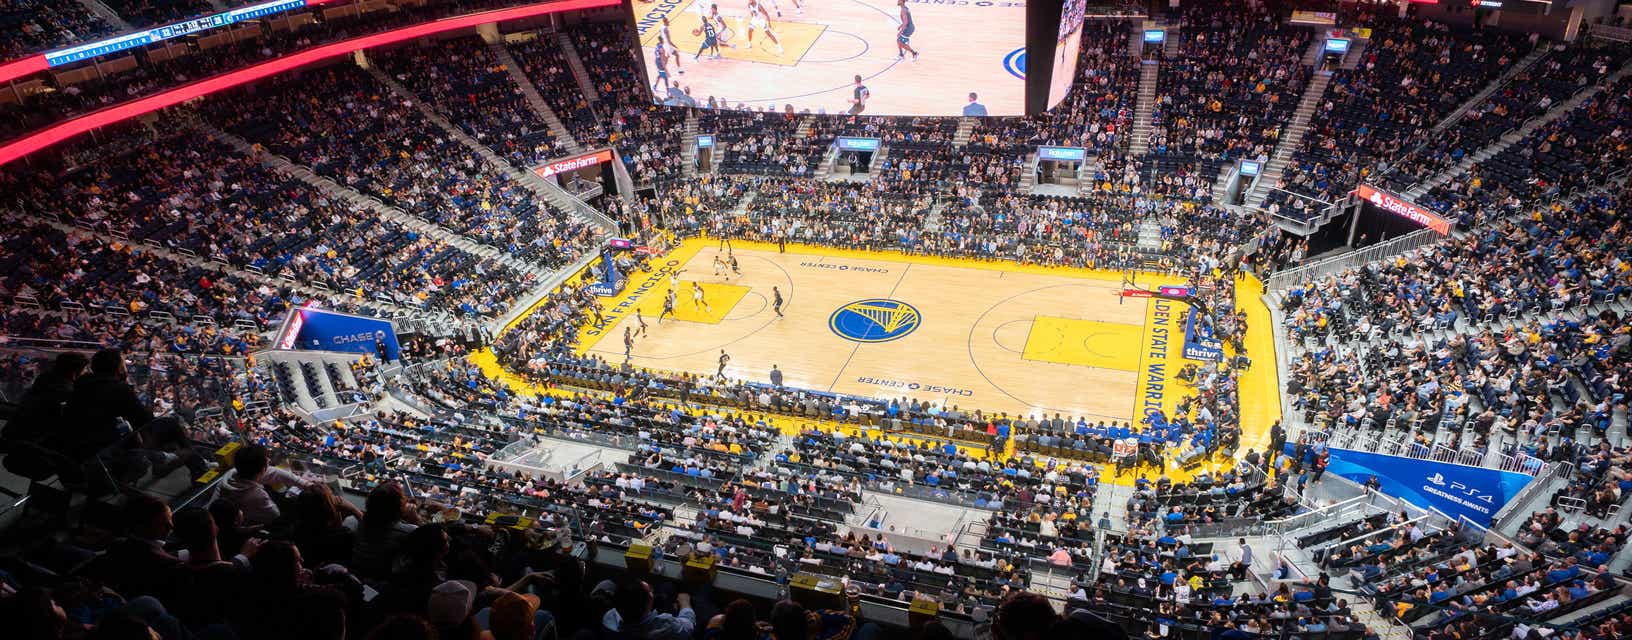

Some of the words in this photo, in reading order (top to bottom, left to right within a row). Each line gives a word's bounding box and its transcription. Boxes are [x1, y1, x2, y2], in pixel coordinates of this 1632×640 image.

[587, 315, 617, 336] SAN
[611, 260, 679, 313] FRANCISCO
[1153, 299, 1170, 325] LDEN
[333, 332, 373, 344] CHASE
[1150, 328, 1168, 359] STATE
[857, 376, 905, 389] CENTER
[923, 385, 973, 397] CHASE
[1143, 363, 1166, 419] WARRIO
[1423, 485, 1462, 504] GREATNESS
[1462, 500, 1489, 514] AWAITS
[1450, 481, 1494, 504] PS4
